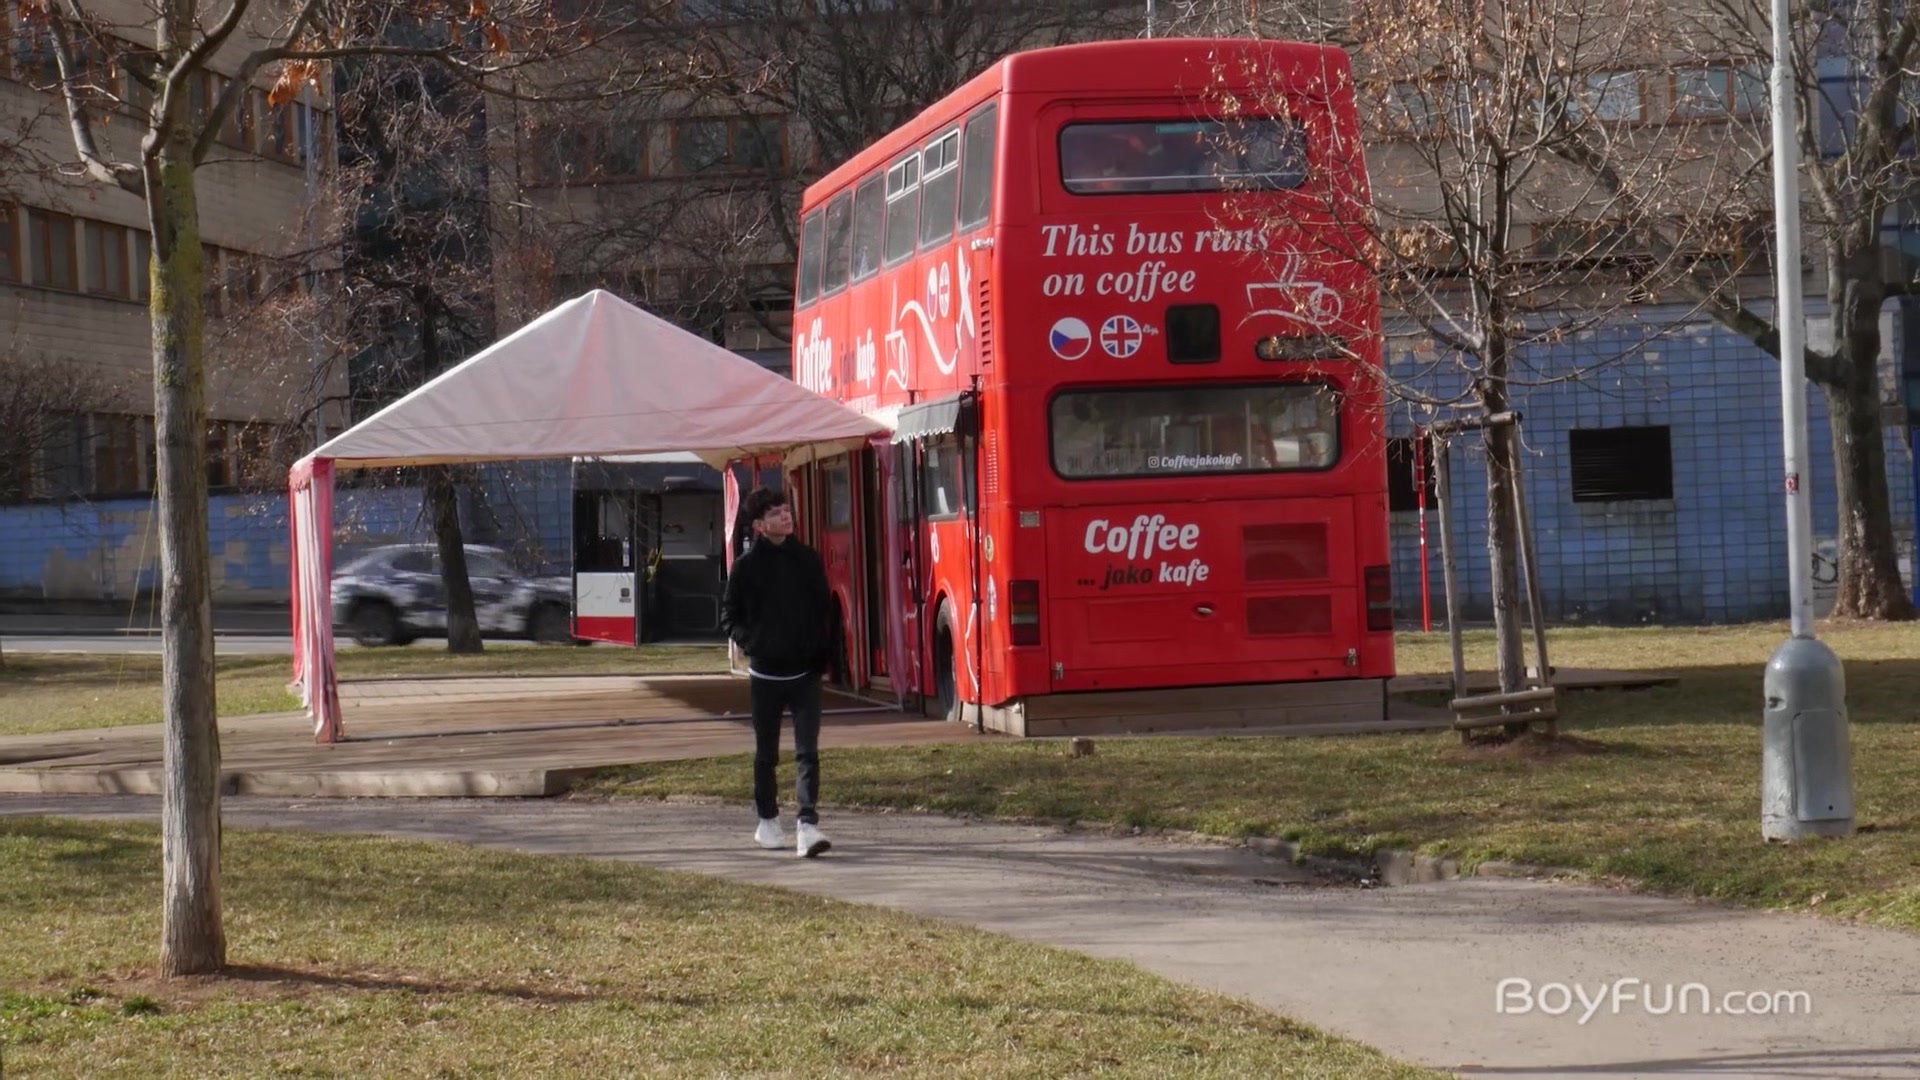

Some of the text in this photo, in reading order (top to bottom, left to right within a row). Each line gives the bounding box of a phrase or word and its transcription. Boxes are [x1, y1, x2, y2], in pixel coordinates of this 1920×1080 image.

[1041, 222, 1270, 257] This bus runs
[1043, 260, 1196, 303] on coffee
[796, 317, 832, 394] Coffee
[1161, 453, 1242, 469] Coffeejakokafe
[1084, 514, 1200, 560] Coffee
[1099, 563, 1153, 591] jako
[1159, 558, 1209, 587] kafe
